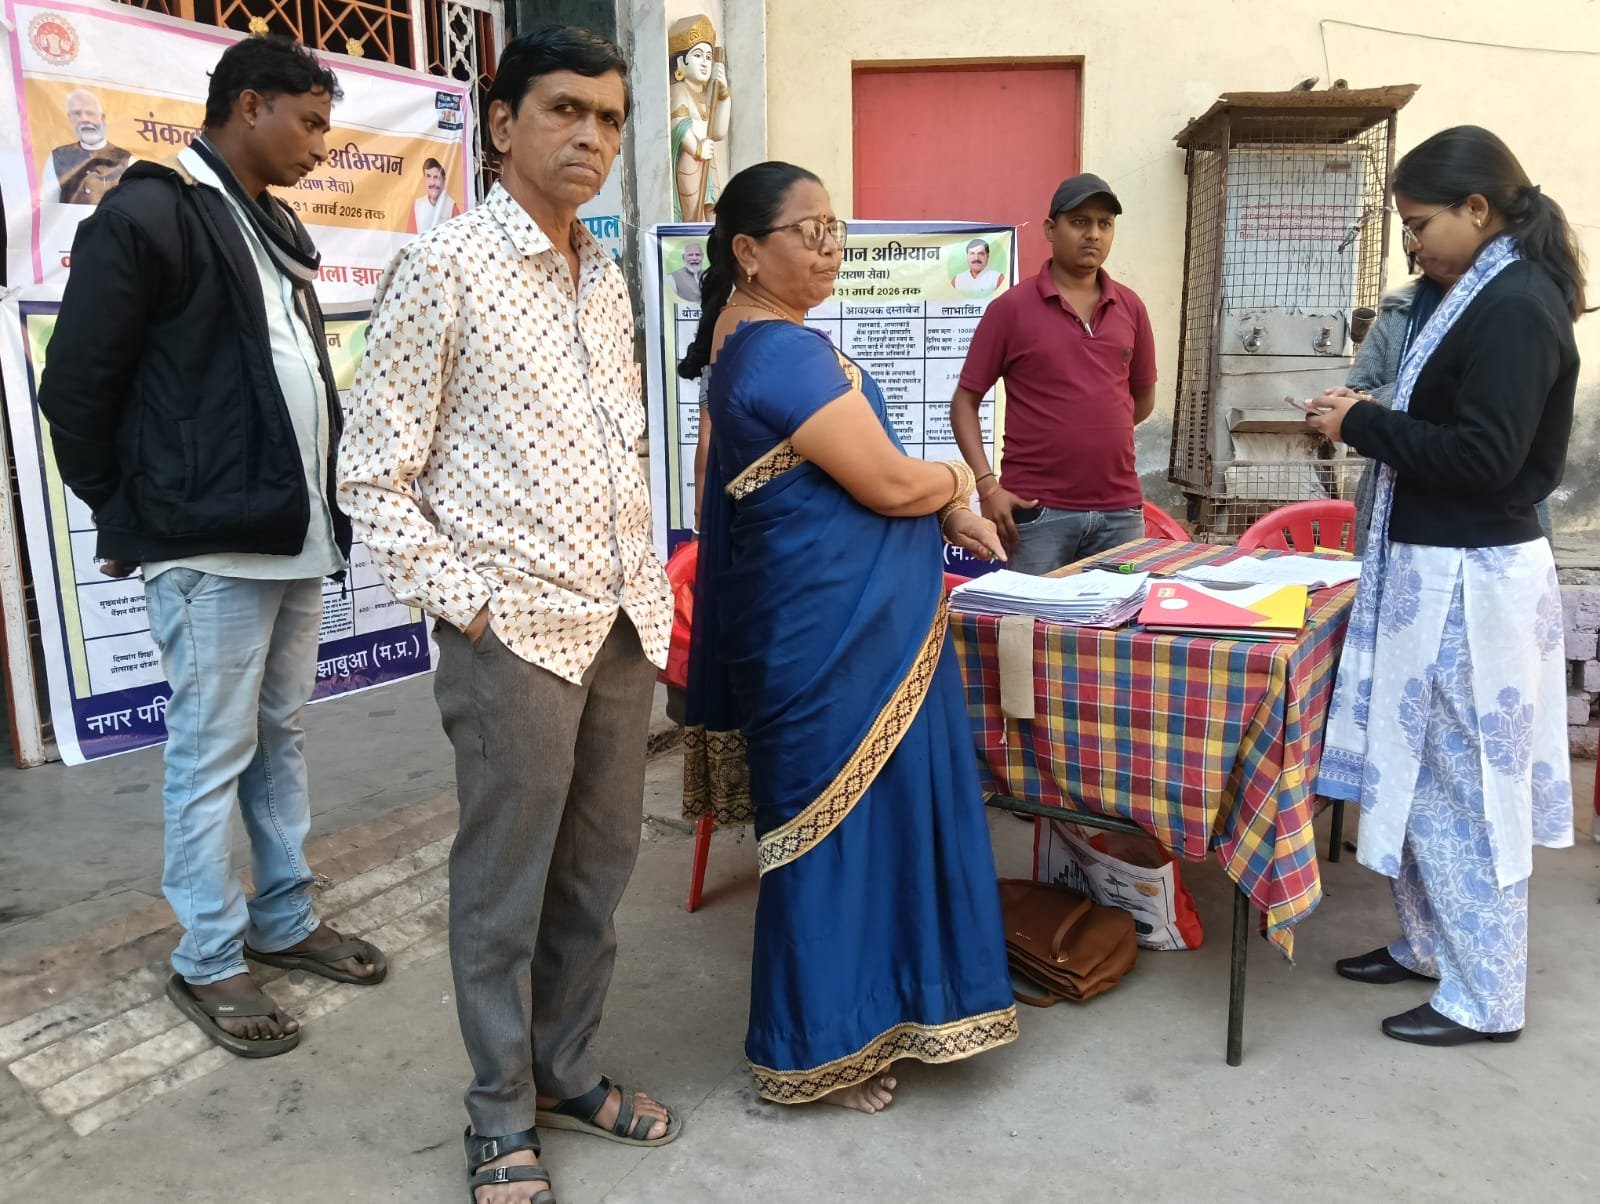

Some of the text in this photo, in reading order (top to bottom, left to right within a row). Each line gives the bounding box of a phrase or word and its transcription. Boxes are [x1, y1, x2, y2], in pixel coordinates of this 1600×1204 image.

[133, 111, 405, 175] संकल अभियान
[326, 176, 354, 194] सेवा)
[293, 201, 308, 212] 31
[312, 201, 338, 215] मार्च
[340, 205, 362, 218] 2026
[364, 208, 385, 220] तक
[581, 214, 620, 239] पल
[872, 240, 941, 262] अभियान
[867, 267, 890, 280] सेवा)
[838, 285, 921, 296] 31 मार्च 2026 तक
[846, 303, 920, 315] आवश्यक दस्तावेज
[317, 634, 420, 677] झाबुआ (म.प्र.)
[86, 709, 132, 734] नगर
